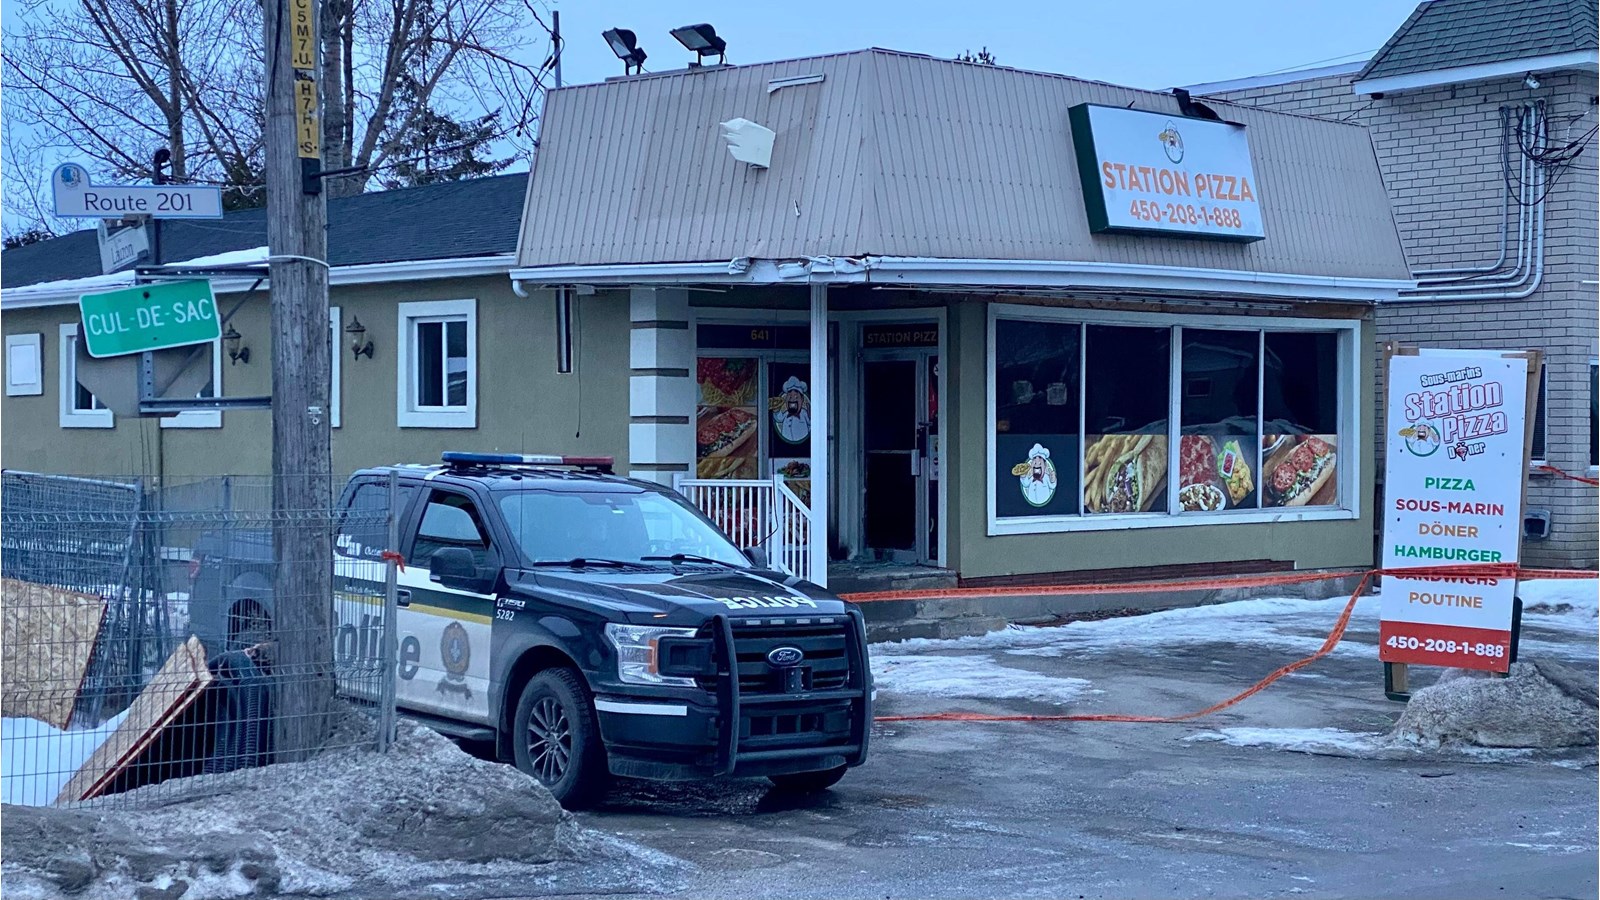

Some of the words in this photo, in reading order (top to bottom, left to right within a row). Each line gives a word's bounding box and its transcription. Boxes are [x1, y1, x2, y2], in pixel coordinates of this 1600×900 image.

[1102, 161, 1191, 197] STATION
[1195, 173, 1256, 202] PIZZA
[84, 192, 148, 211] Route
[156, 192, 193, 211] 201
[1130, 199, 1242, 228] 450-208-1-888
[88, 298, 212, 336] CUL-DE-SAC
[750, 329, 769, 341] 641
[867, 331, 911, 344] STATION
[1420, 366, 1483, 387] Sous-marins
[1404, 381, 1503, 423] Station
[1442, 411, 1508, 444] Pizza
[1425, 477, 1475, 491] PIZZA
[1395, 498, 1504, 516] SOUS-MARIN
[1418, 521, 1478, 538] DÖNER
[1394, 545, 1502, 562] HAMBURGER
[1409, 592, 1483, 608] POUTINE
[496, 609, 515, 621] 5282
[1386, 635, 1504, 657] 450-208-1-888
[776, 650, 796, 661] Ford
